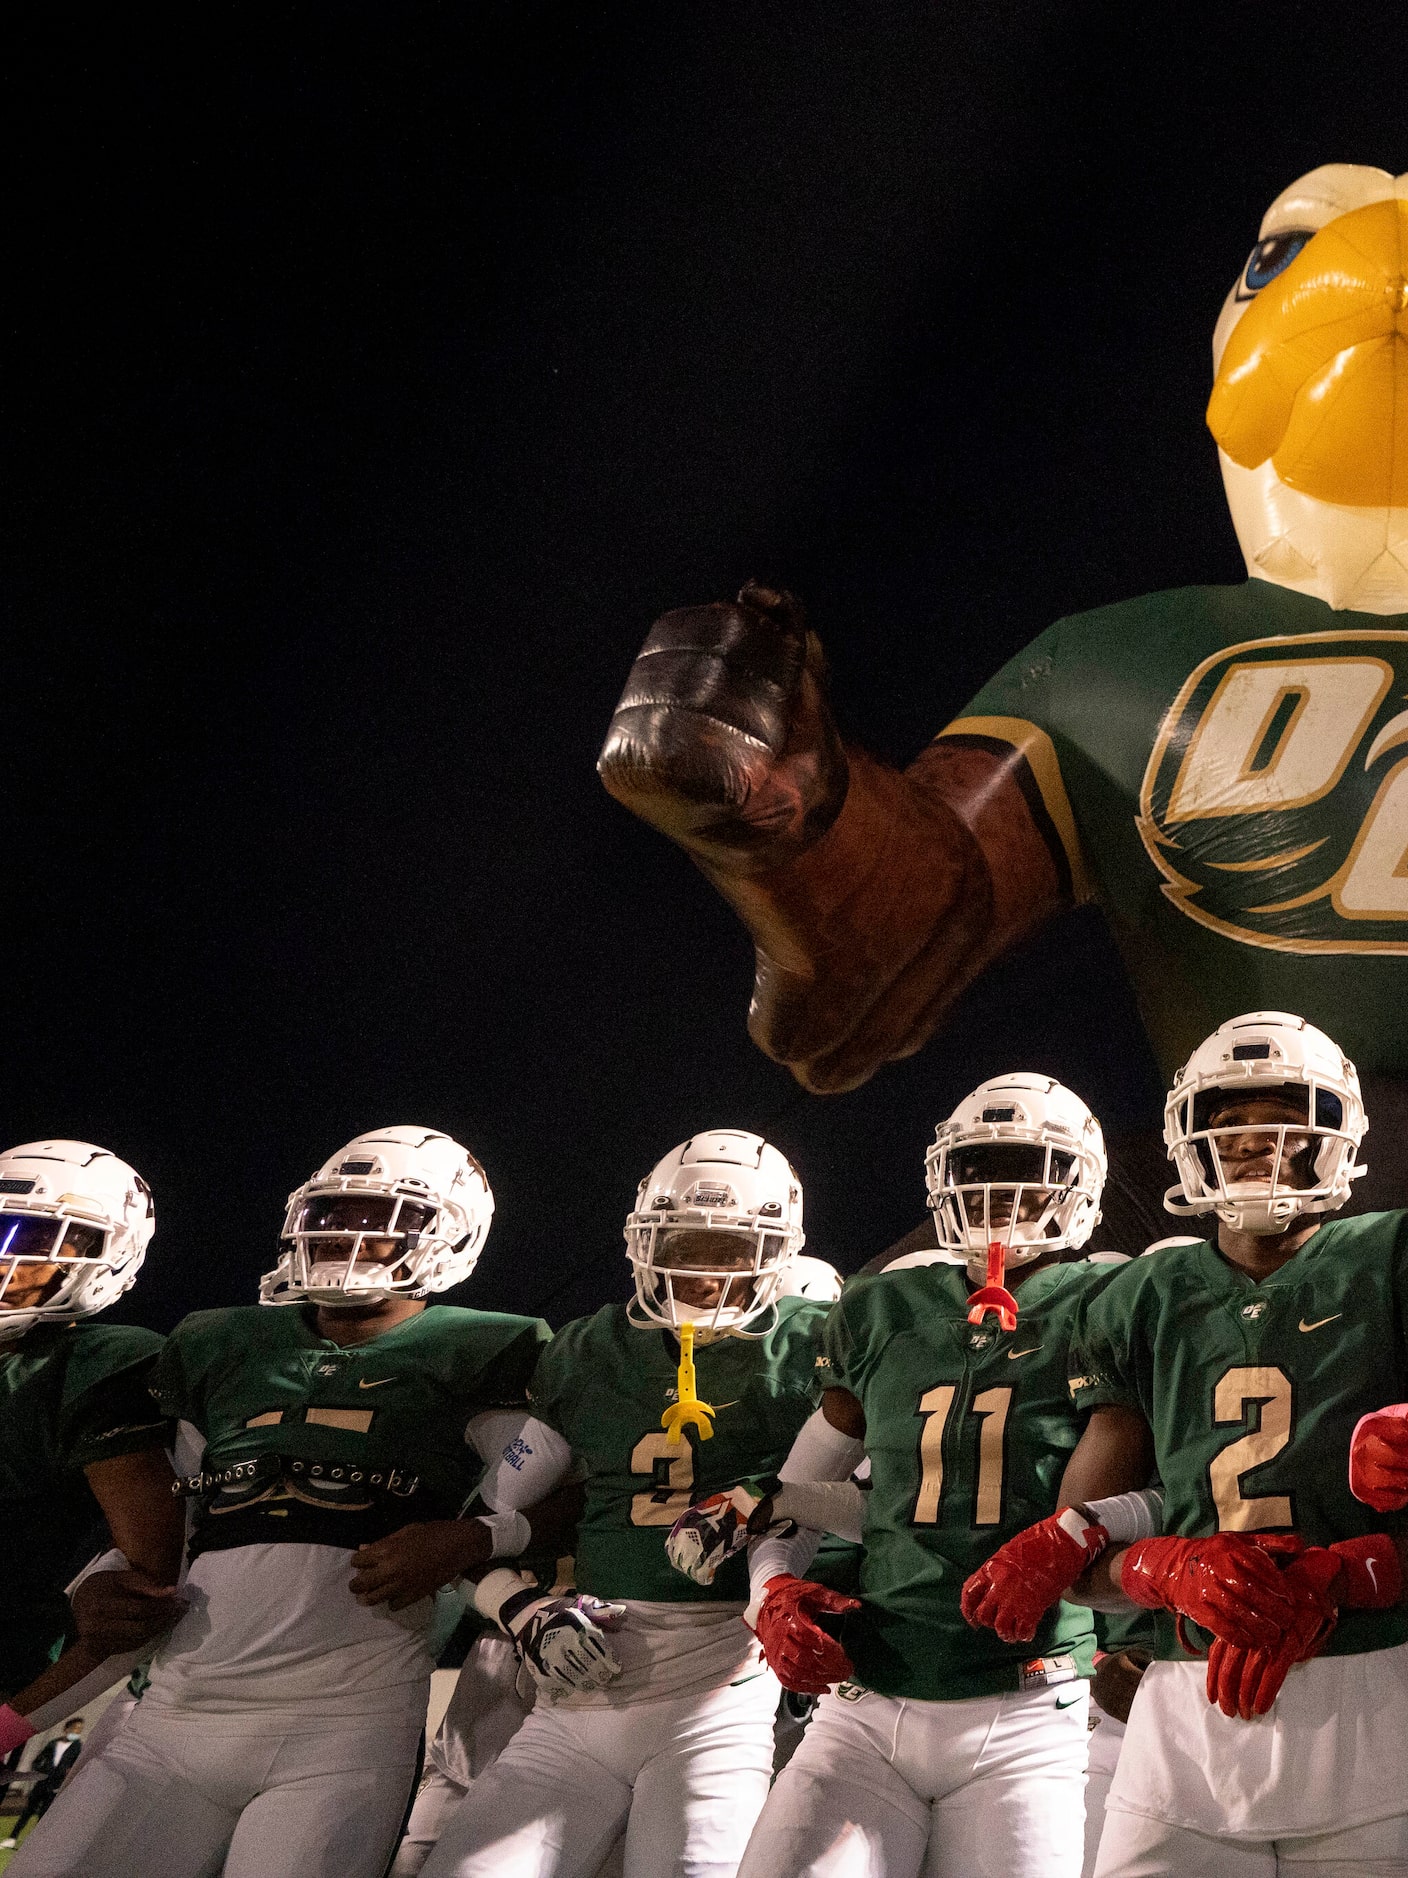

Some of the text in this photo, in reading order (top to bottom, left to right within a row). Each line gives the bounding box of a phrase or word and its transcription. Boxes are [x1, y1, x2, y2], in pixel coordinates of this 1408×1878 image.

[628, 1431, 696, 1527] 3
[913, 1384, 1015, 1528] 11
[1208, 1365, 1296, 1533] 2
